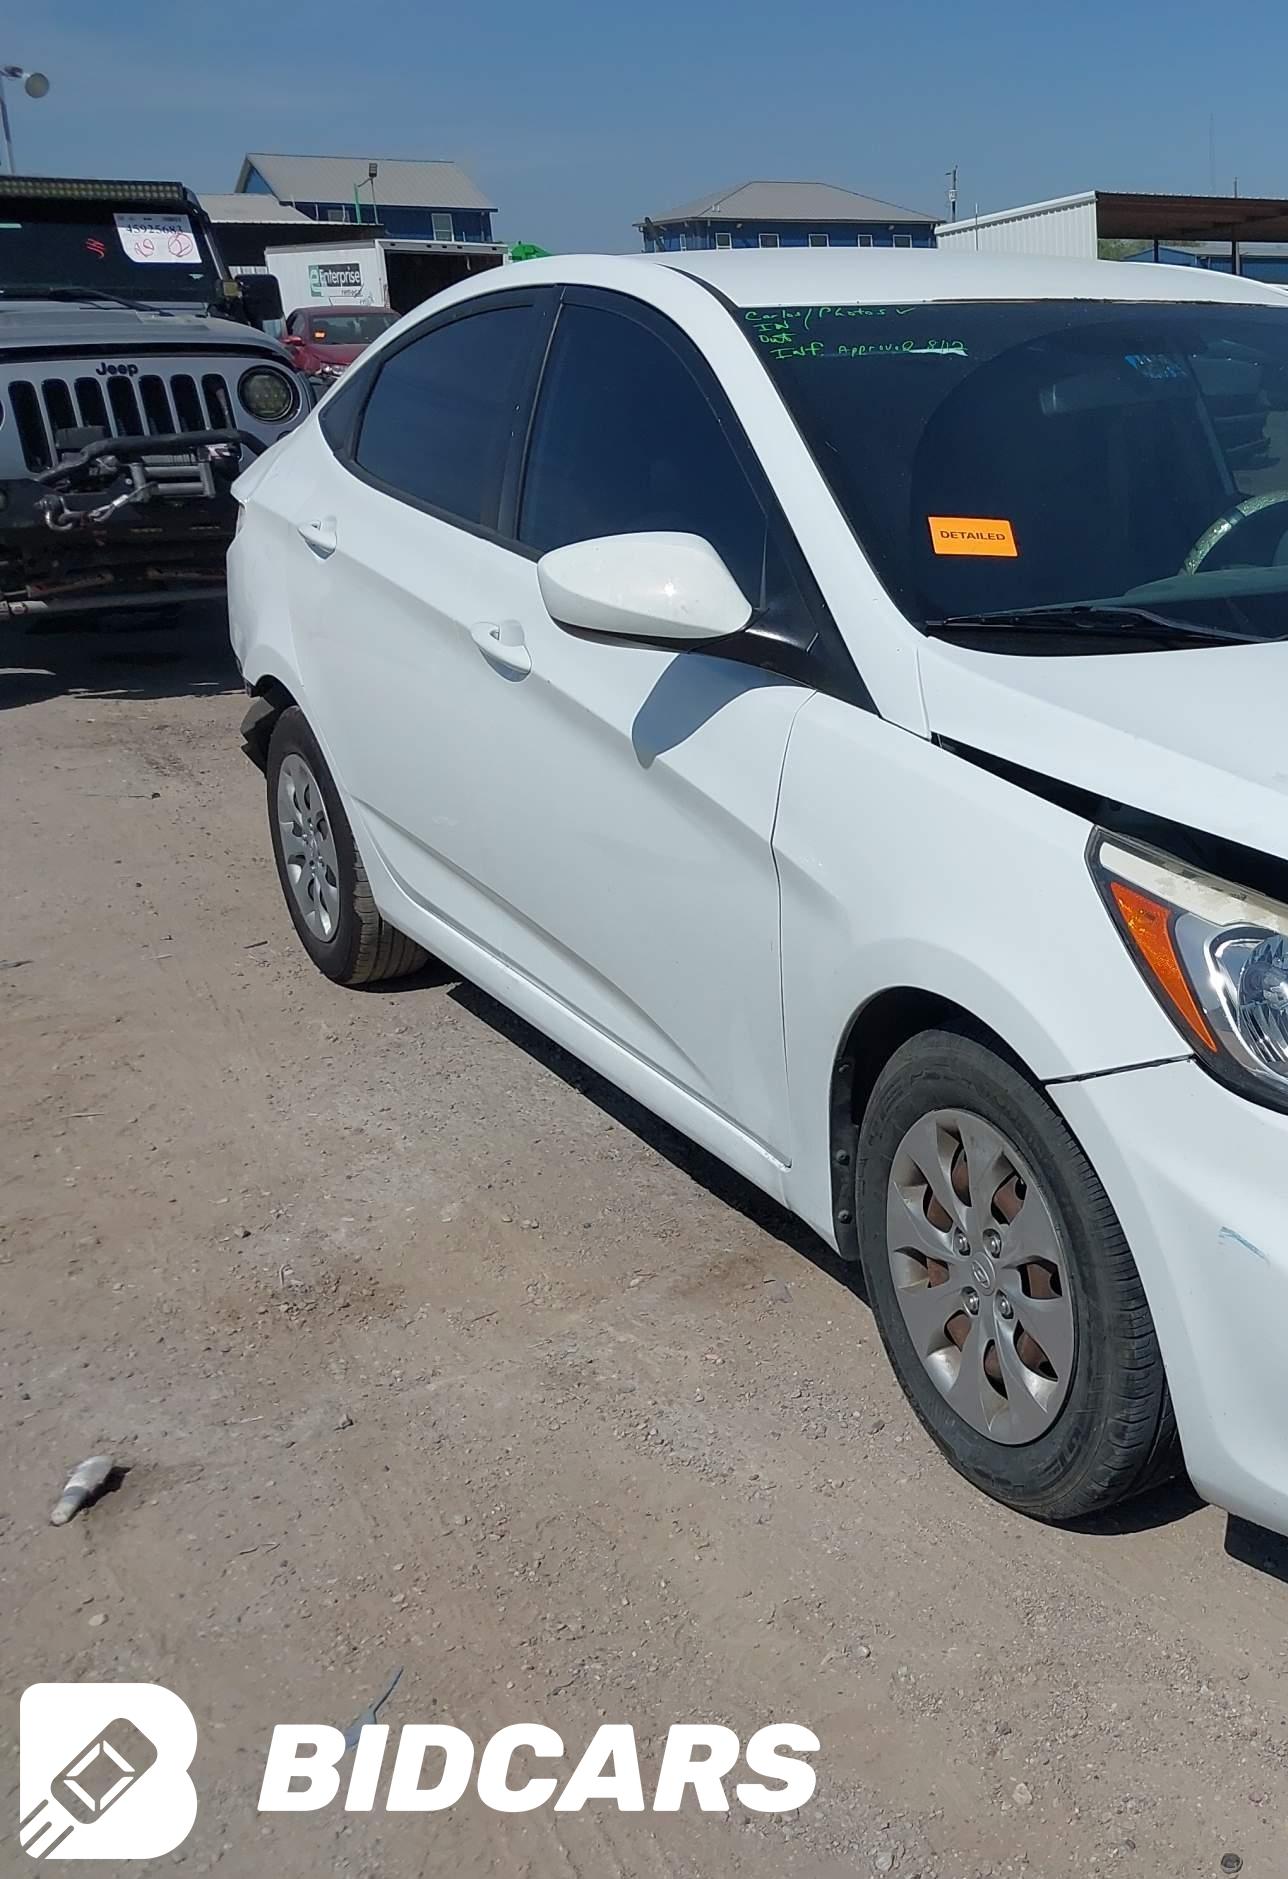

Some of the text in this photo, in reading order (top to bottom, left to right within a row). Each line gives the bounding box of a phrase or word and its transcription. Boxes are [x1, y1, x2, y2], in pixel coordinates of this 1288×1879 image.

[320, 265, 360, 288] Enterprise
[96, 361, 138, 377] Jeep
[940, 530, 1006, 541] DETAILED
